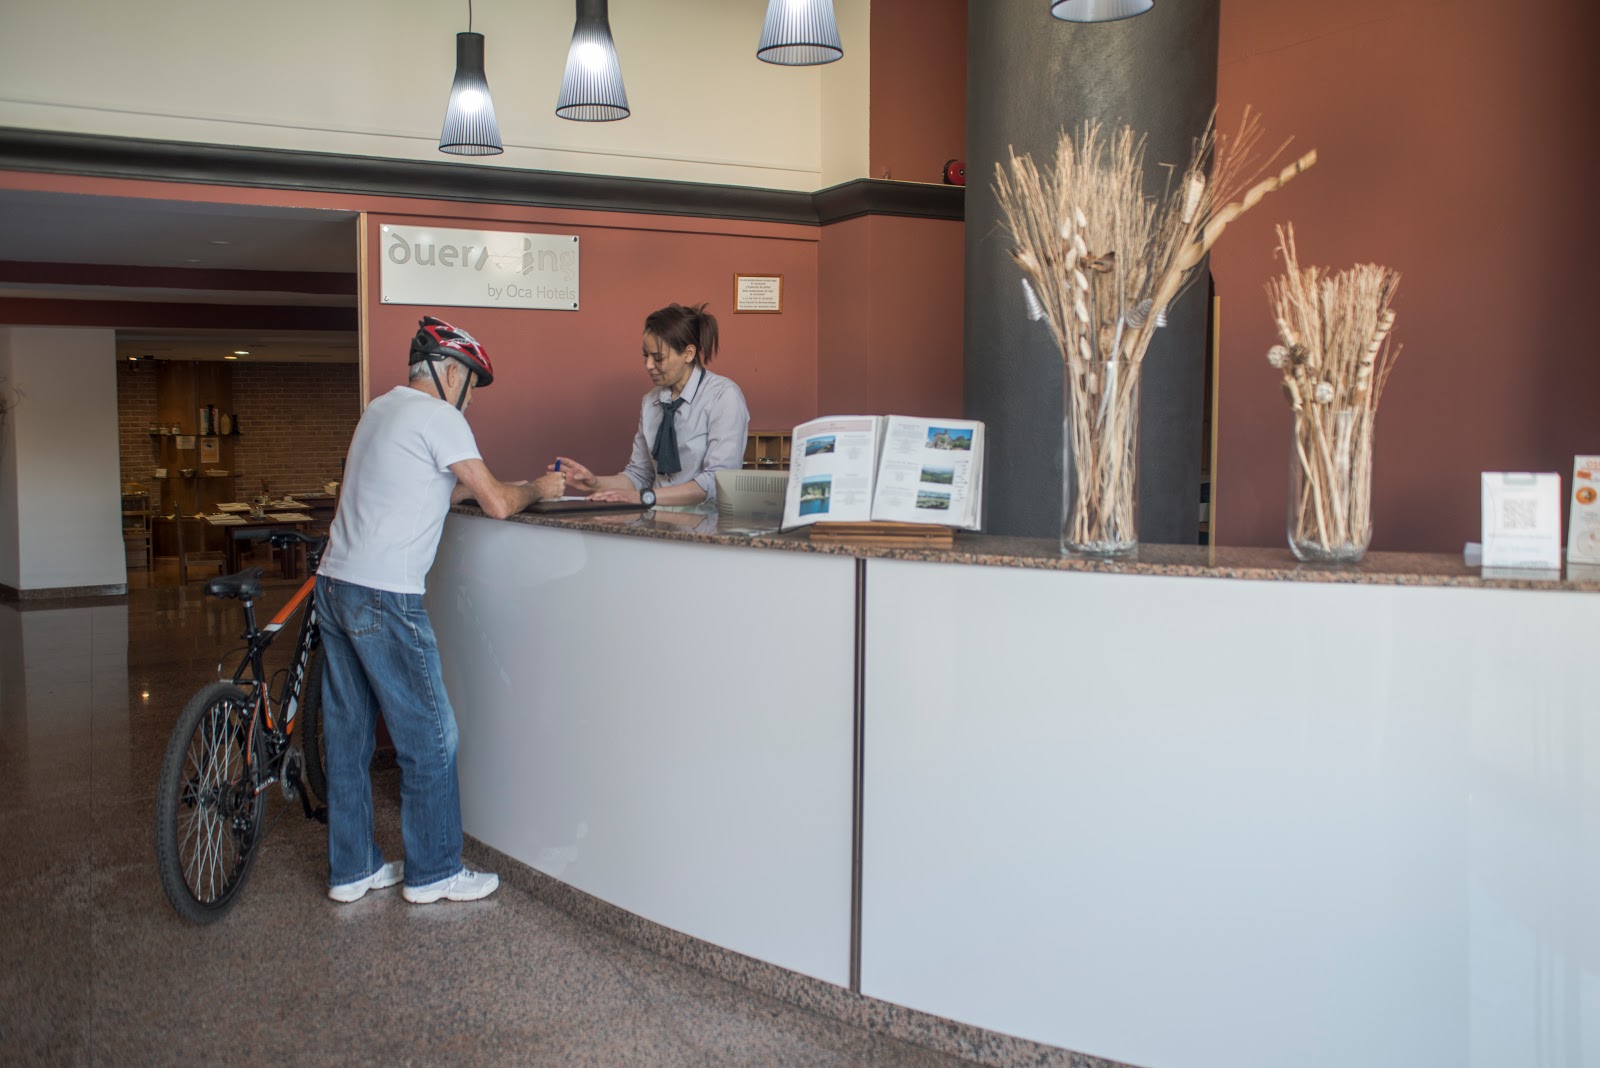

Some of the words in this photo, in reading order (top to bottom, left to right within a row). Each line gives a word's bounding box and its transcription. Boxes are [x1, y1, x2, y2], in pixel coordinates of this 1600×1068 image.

[388, 233, 575, 282] duering
[487, 283, 503, 301] by
[506, 284, 533, 299] Oca
[537, 286, 576, 300] Hotels
